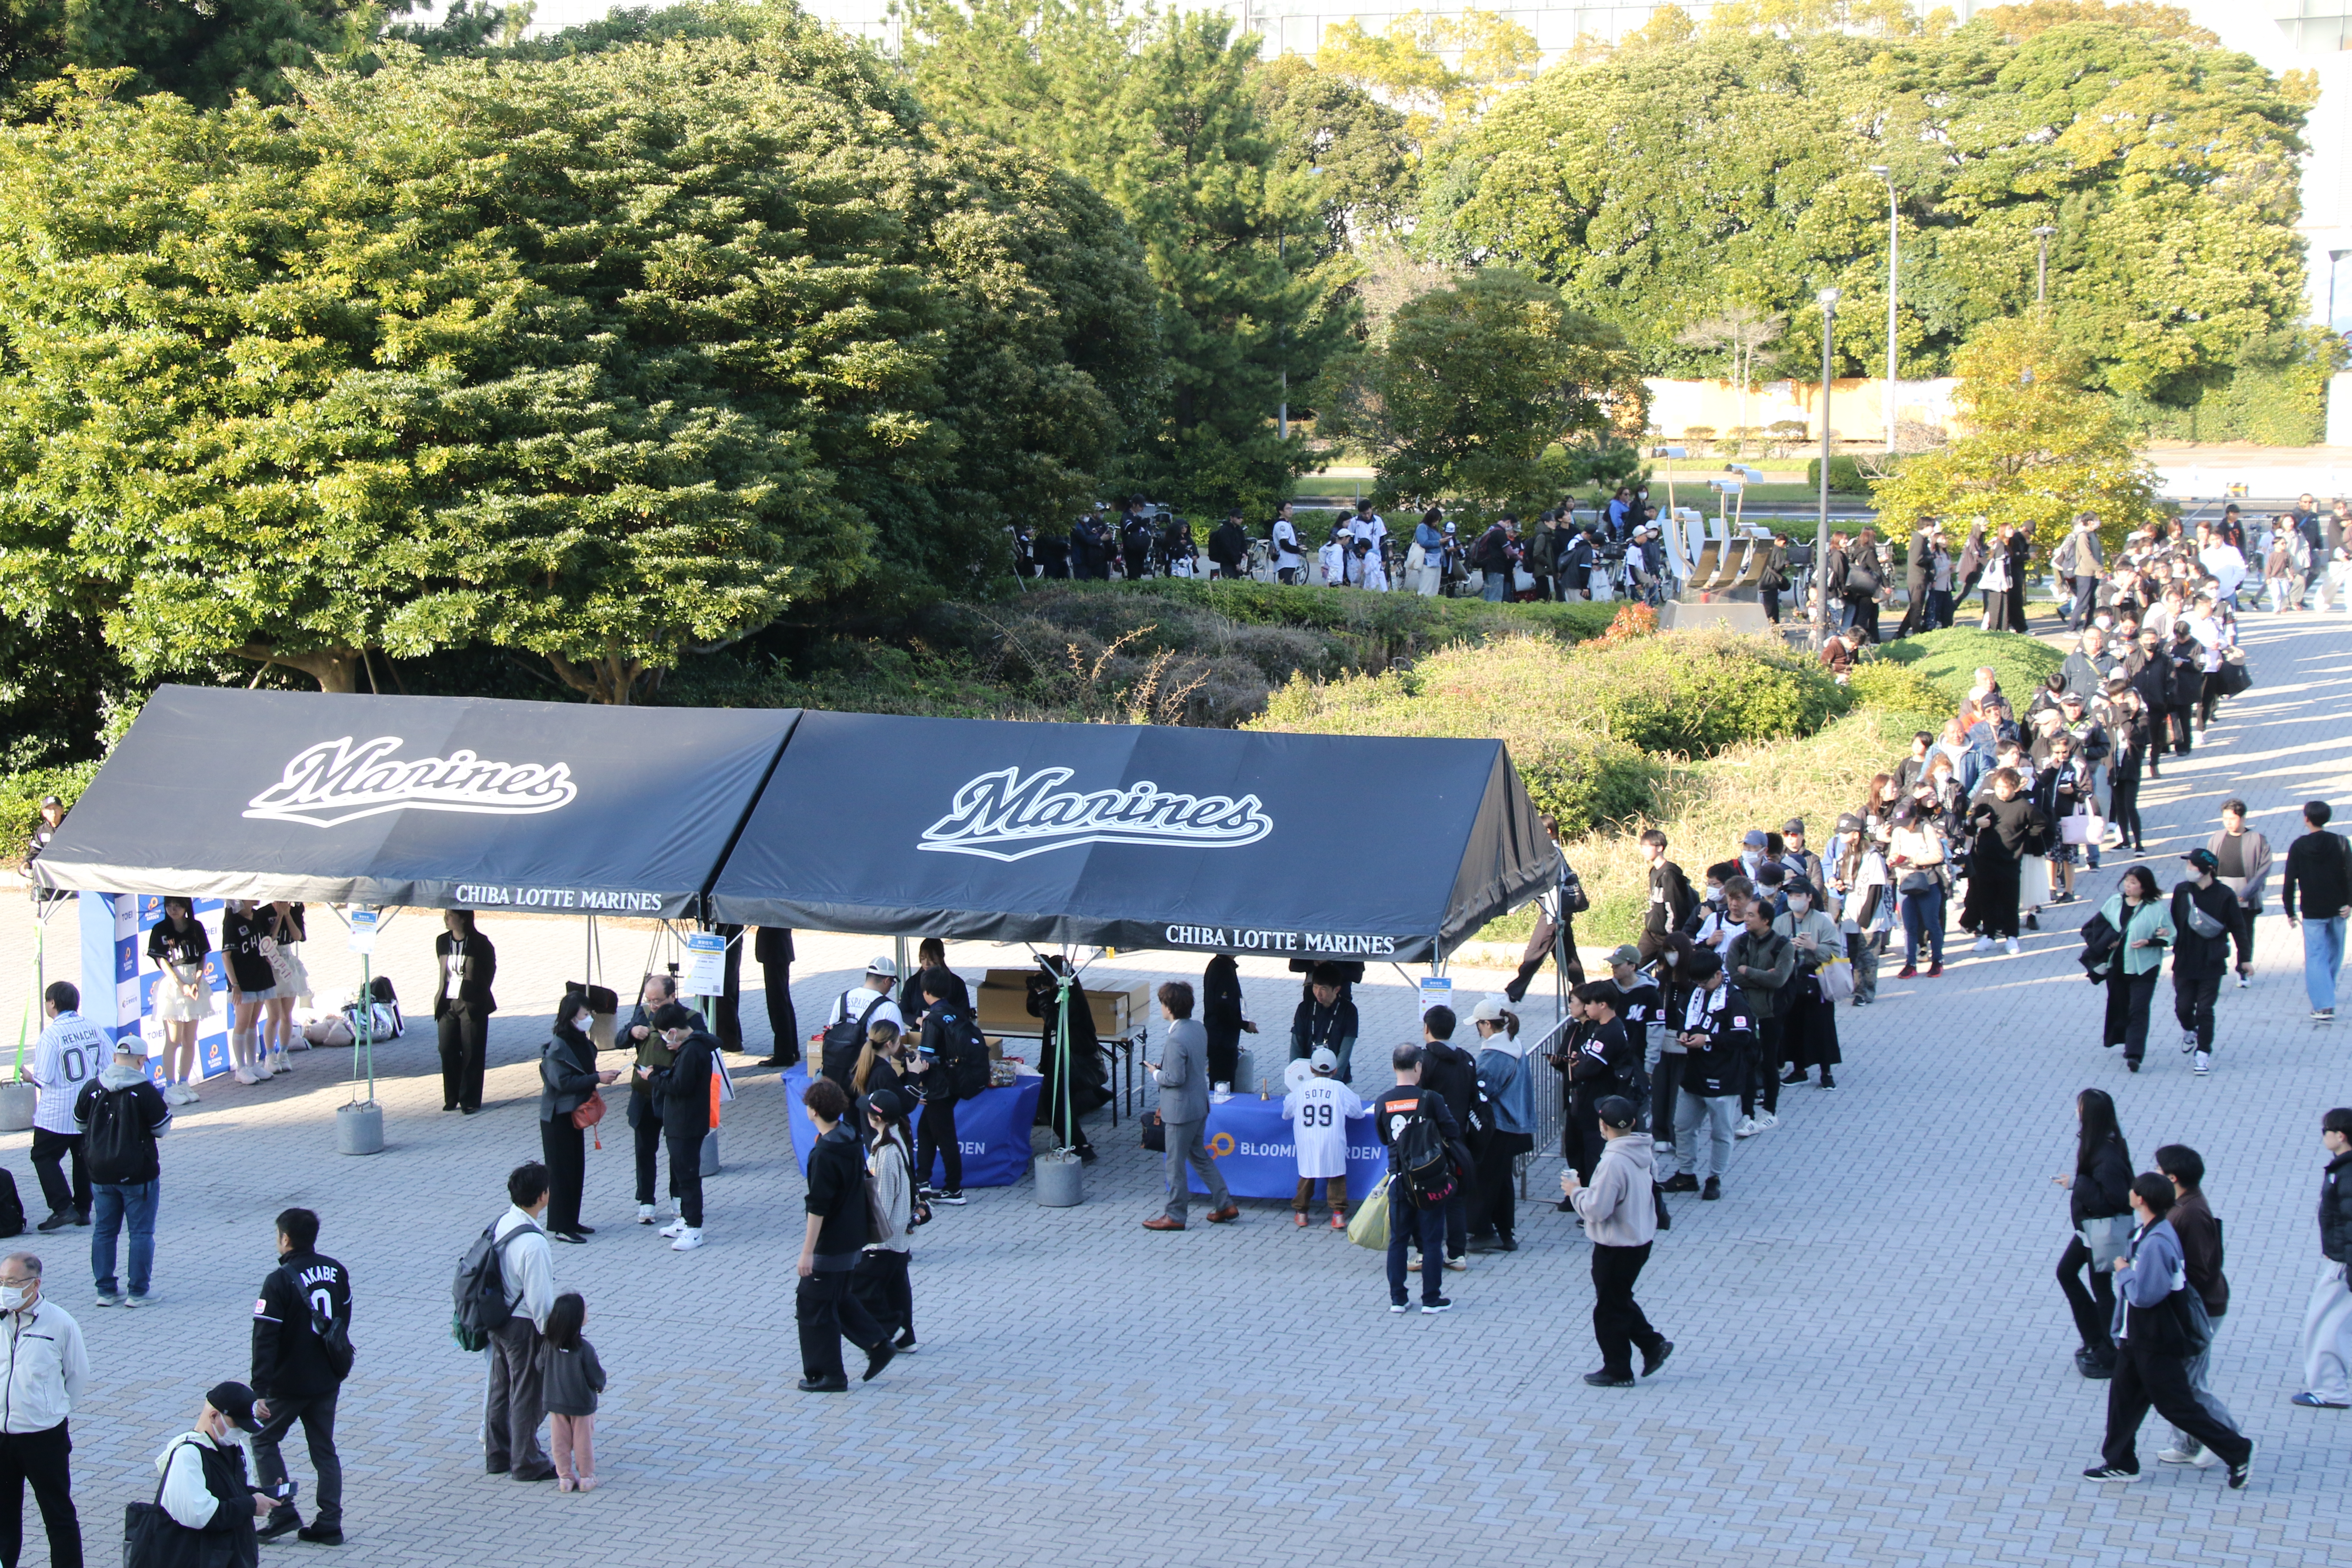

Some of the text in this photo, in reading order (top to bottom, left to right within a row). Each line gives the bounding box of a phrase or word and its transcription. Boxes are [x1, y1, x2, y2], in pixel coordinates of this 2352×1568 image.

[242, 736, 577, 827] Marines
[916, 766, 1273, 862] Marines
[456, 885, 662, 911] CHIBA LOTTE MARINES
[242, 932, 263, 954] CHI
[1165, 925, 1395, 955] CHIBA LOTTE MARINES
[847, 997, 870, 1010] ESPAIG
[1698, 1012, 1719, 1034] IBA
[62, 1029, 97, 1045] RENACHI
[61, 1041, 101, 1084] 07
[1305, 1089, 1332, 1099] SOTO
[1304, 1105, 1332, 1127] 99
[957, 1142, 985, 1155] DEN
[1240, 1142, 1381, 1160] BLOOMI RDEN
[300, 1265, 338, 1287] AKABE
